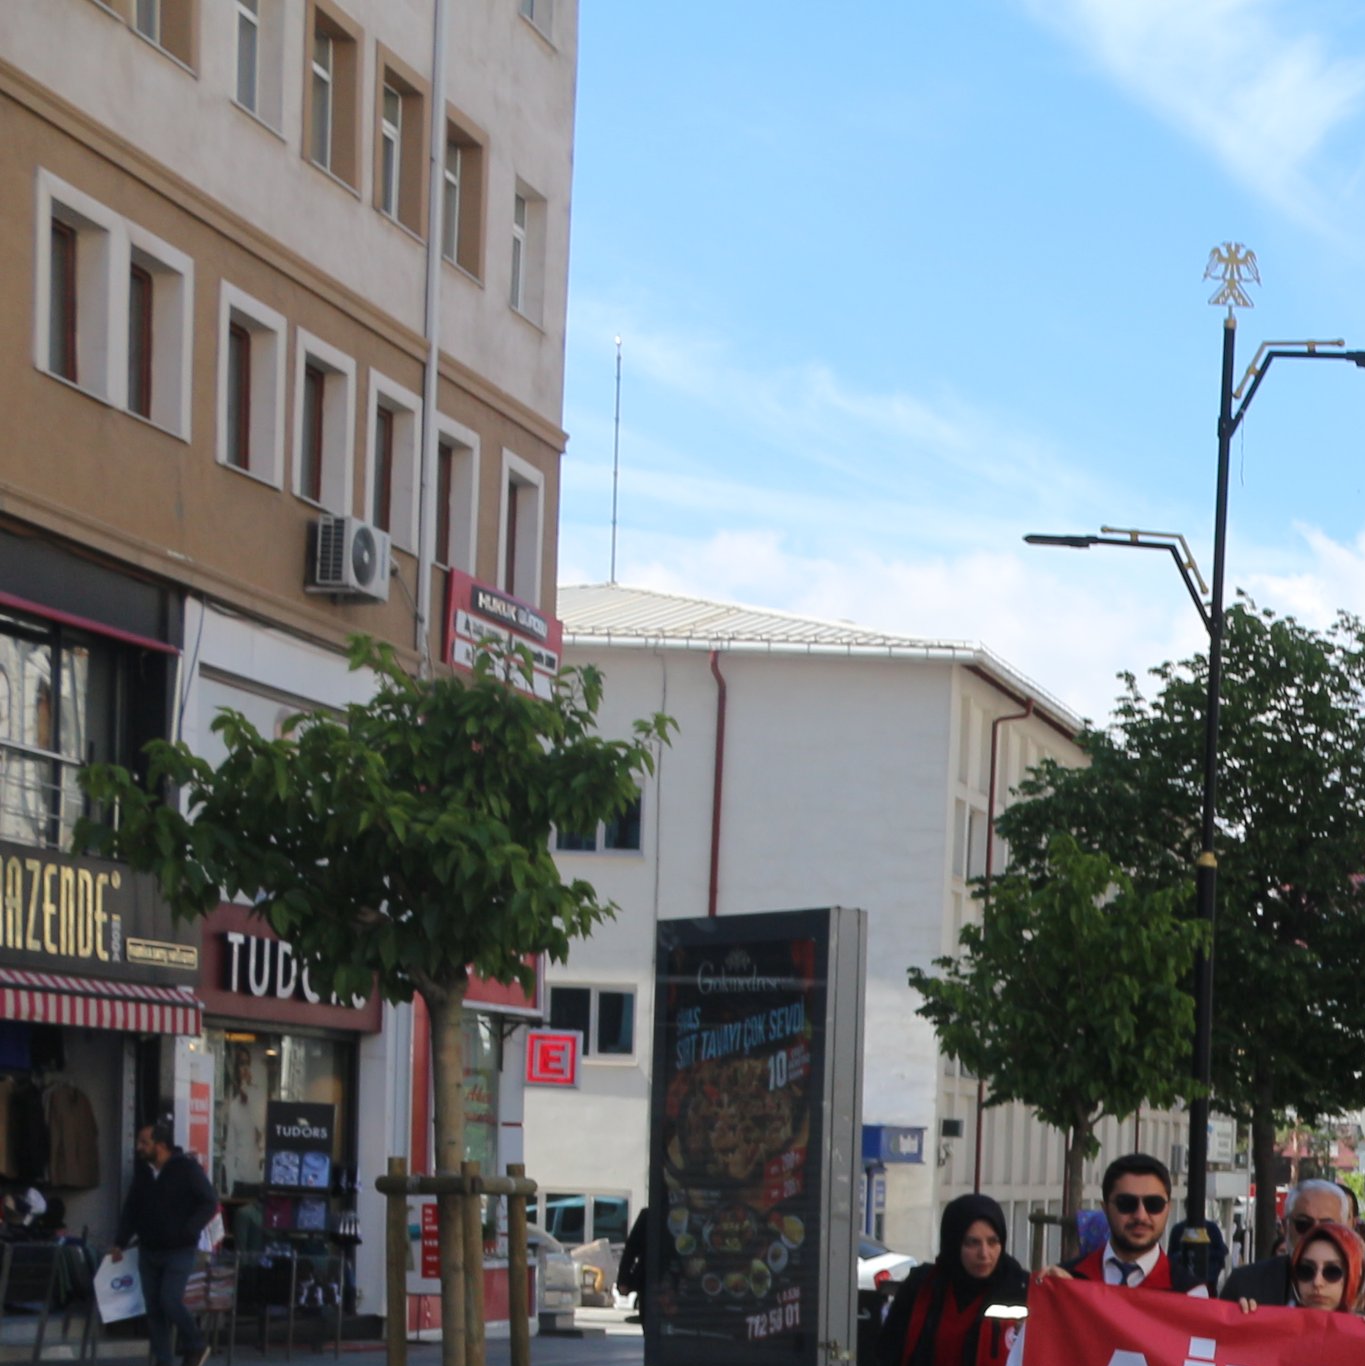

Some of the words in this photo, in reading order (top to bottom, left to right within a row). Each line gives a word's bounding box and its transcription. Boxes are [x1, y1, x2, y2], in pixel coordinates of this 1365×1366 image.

[0, 855, 110, 962] AZENDE
[768, 1050, 787, 1092] 10
[275, 1124, 328, 1139] TUDORS
